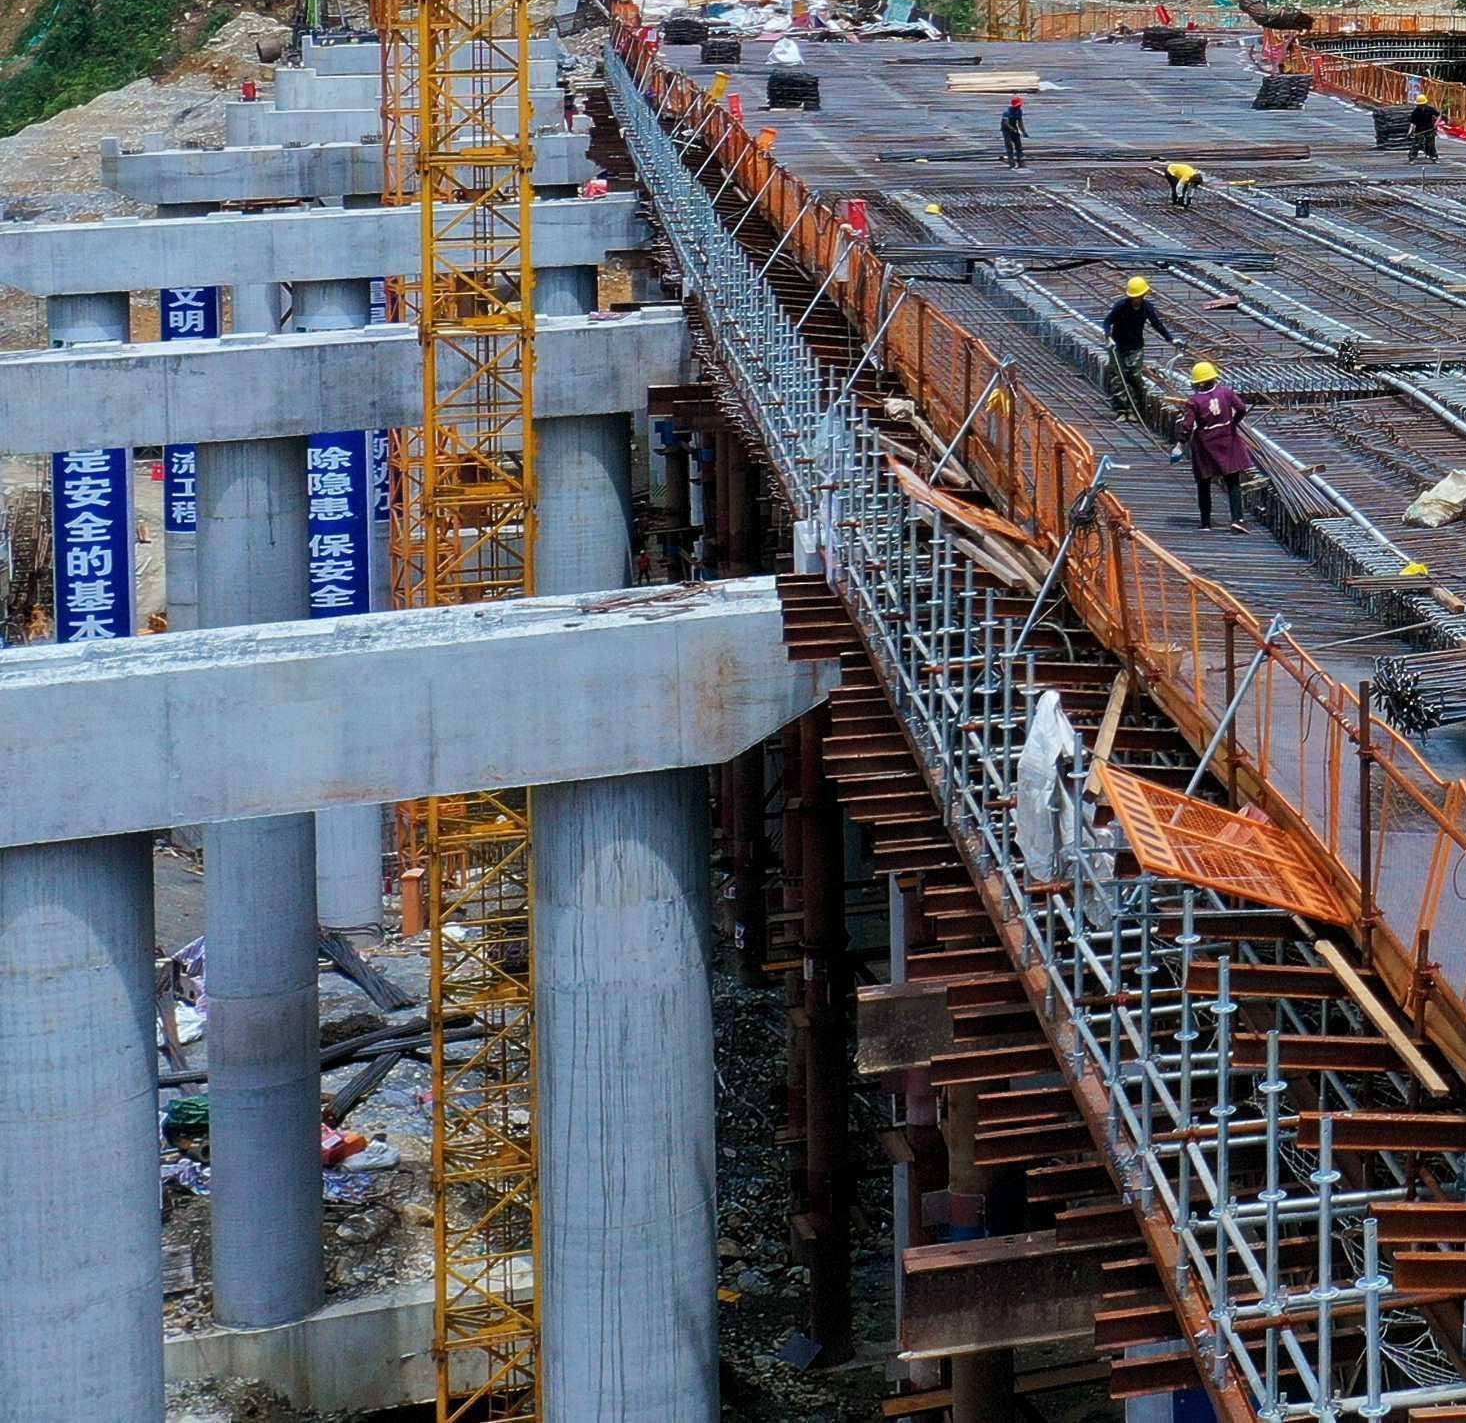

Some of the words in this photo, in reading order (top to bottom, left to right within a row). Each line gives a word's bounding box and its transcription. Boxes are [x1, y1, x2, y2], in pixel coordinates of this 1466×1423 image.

[168, 288, 205, 339] 文明
[307, 447, 354, 520] 除隐患
[309, 533, 356, 607] 保安全
